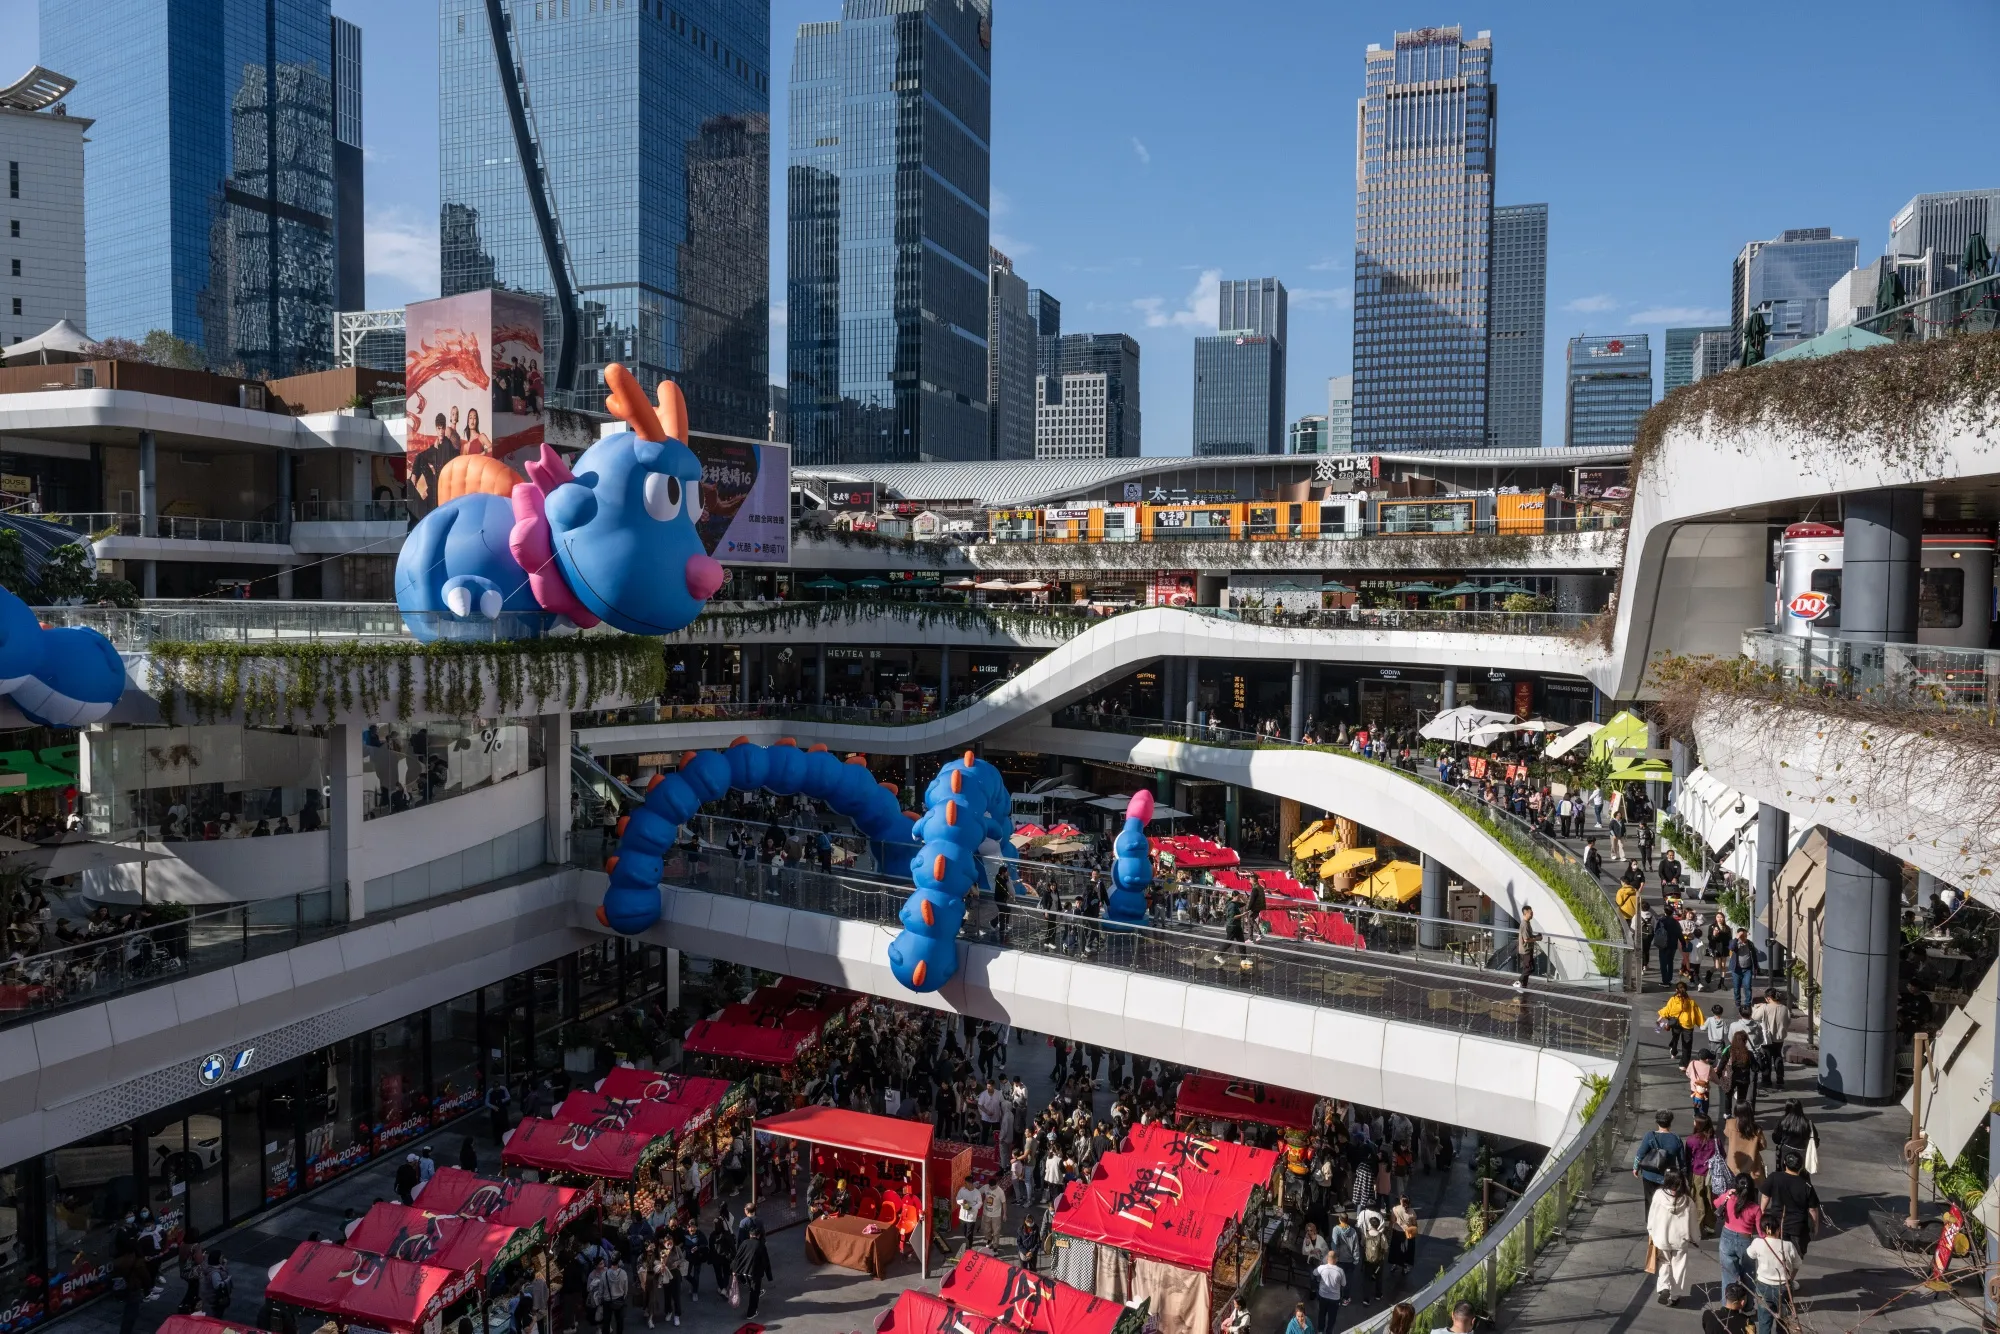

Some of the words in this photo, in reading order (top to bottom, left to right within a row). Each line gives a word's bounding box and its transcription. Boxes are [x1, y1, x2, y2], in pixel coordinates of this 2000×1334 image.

[1148, 486, 1189, 501] 太二
[1518, 502, 1544, 510] 小吃街
[736, 542, 751, 553] 优酷
[1795, 598, 1820, 612] DQ
[827, 649, 864, 658] HEYTEA
[439, 1097, 459, 1114] BMW
[459, 1088, 477, 1104] 2024
[380, 1124, 402, 1142] BMW
[402, 1114, 422, 1131] 2024
[315, 1153, 338, 1173] BMW
[339, 1143, 361, 1161] 2024
[271, 1159, 291, 1173] HAPPY
[274, 1166, 288, 1177] NEW
[272, 1172, 289, 1184] YEAR
[965, 1252, 980, 1272] 02.0
[62, 1268, 97, 1295] BMW
[98, 1261, 114, 1278] 20
[0, 1300, 30, 1325] 024
